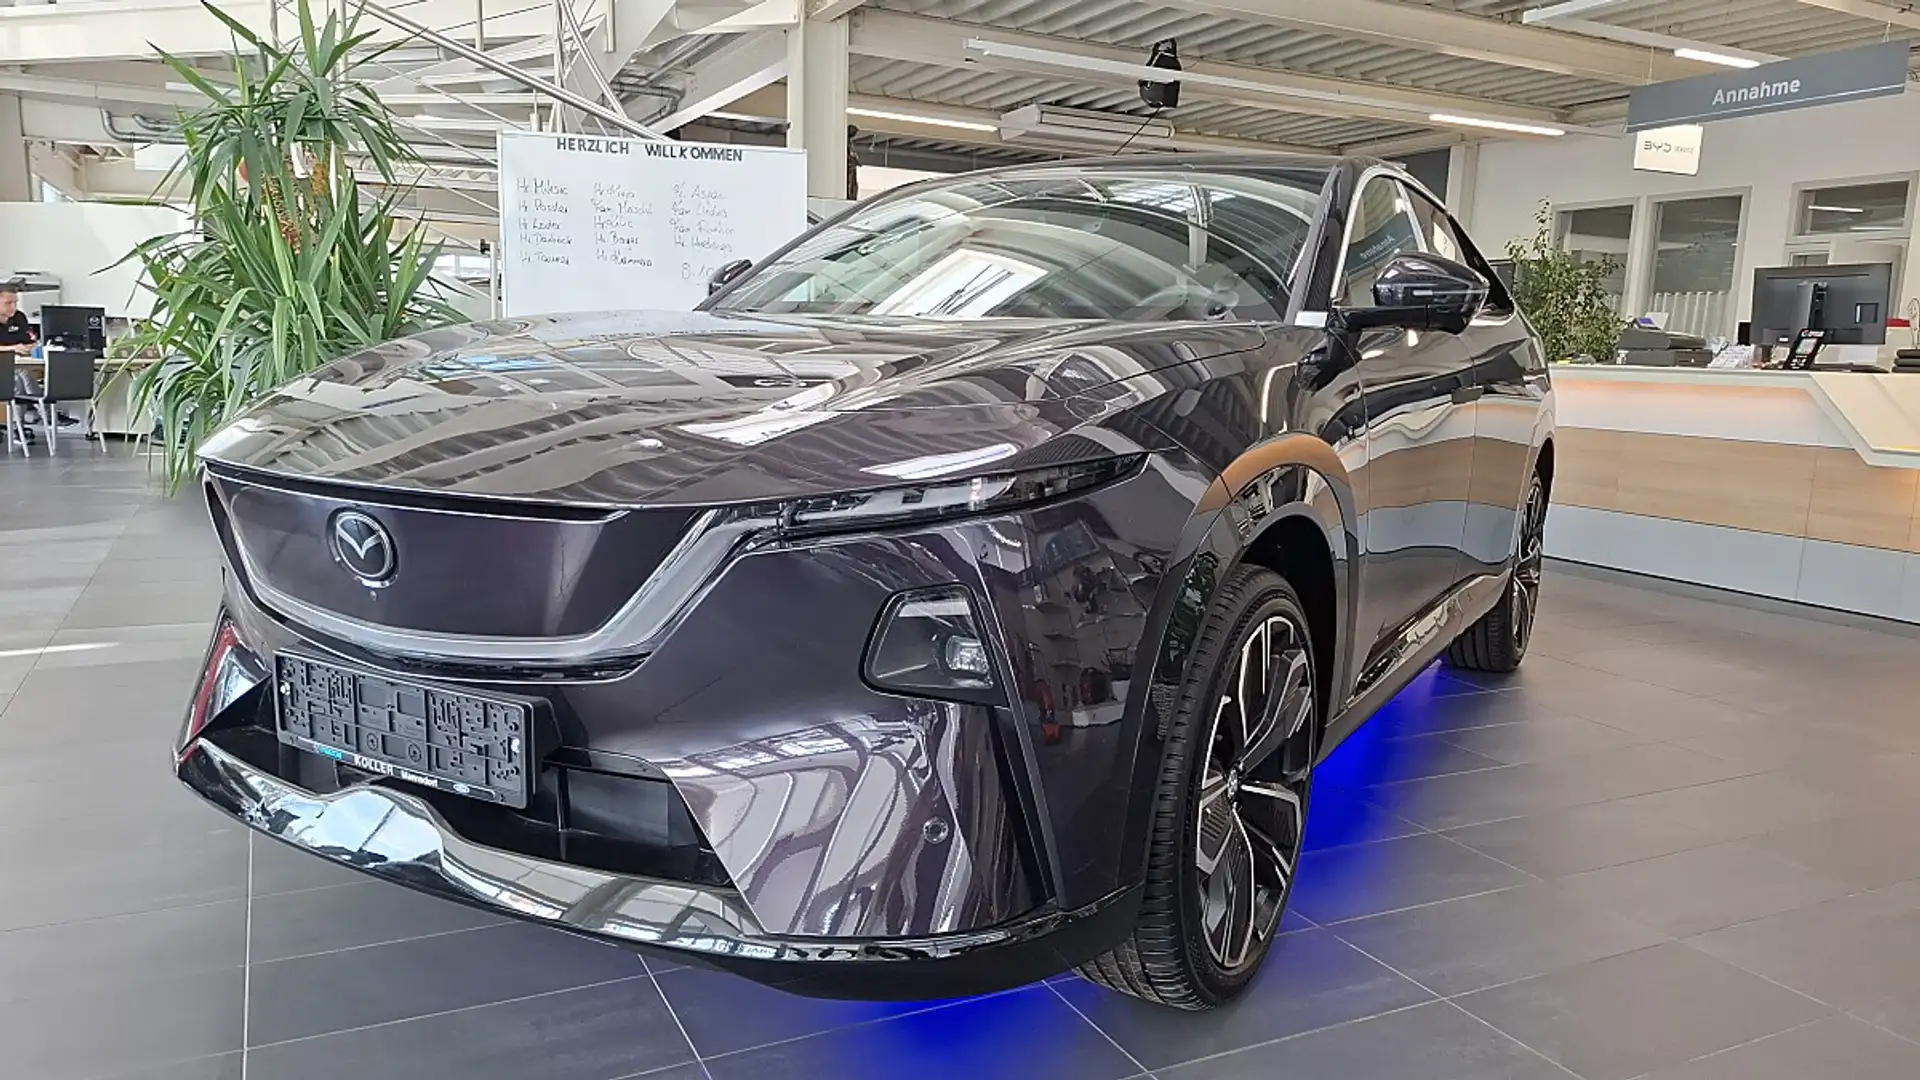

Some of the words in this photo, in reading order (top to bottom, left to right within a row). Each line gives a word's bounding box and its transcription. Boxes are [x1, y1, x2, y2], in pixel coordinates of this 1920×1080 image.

[1712, 79, 1801, 106] Annahme
[556, 138, 629, 154] HERZLICH
[645, 143, 743, 162] WILLKOMMEN
[1643, 140, 1672, 153] BYD
[354, 754, 394, 776] KOLLER
